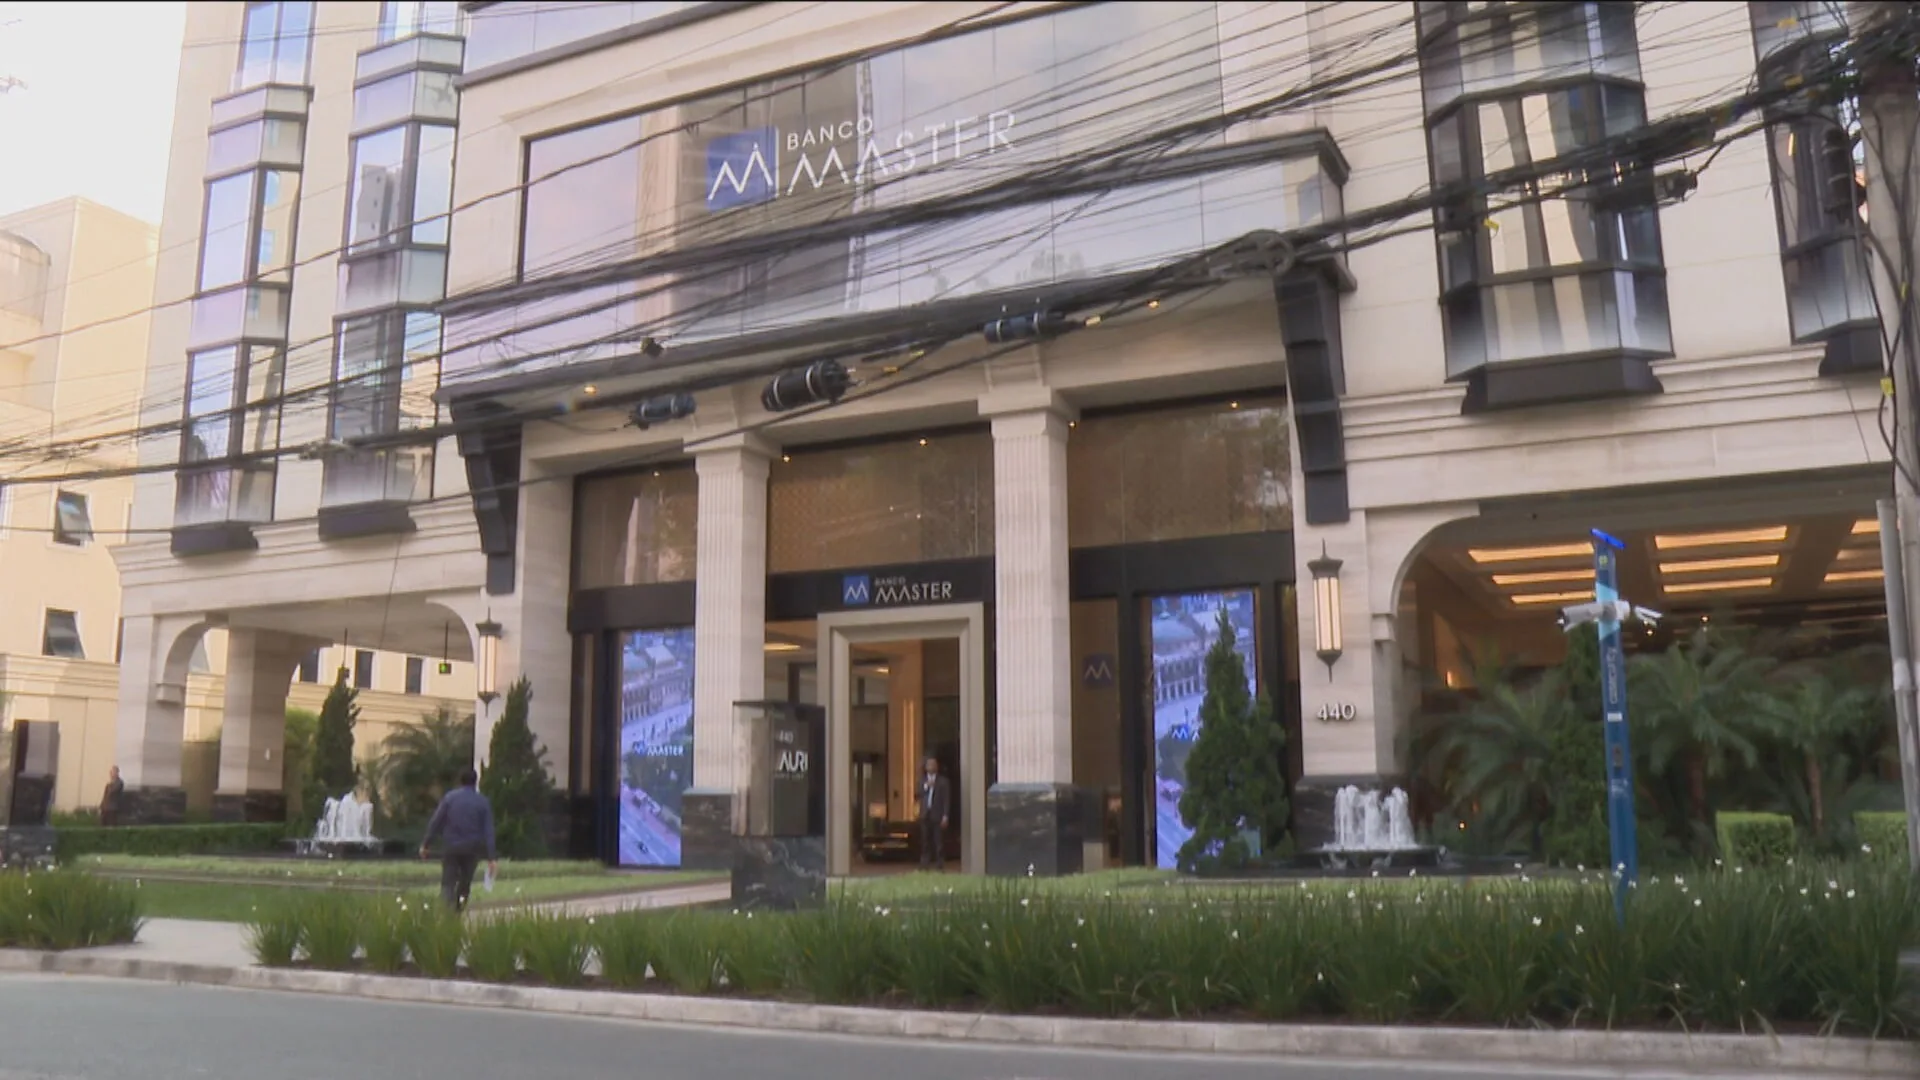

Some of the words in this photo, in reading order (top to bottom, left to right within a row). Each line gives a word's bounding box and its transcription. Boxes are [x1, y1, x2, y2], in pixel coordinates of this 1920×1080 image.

[788, 116, 873, 150] BANCO
[787, 110, 1017, 196] MASTER
[875, 581, 952, 604] MASTER
[1316, 703, 1355, 721] 440
